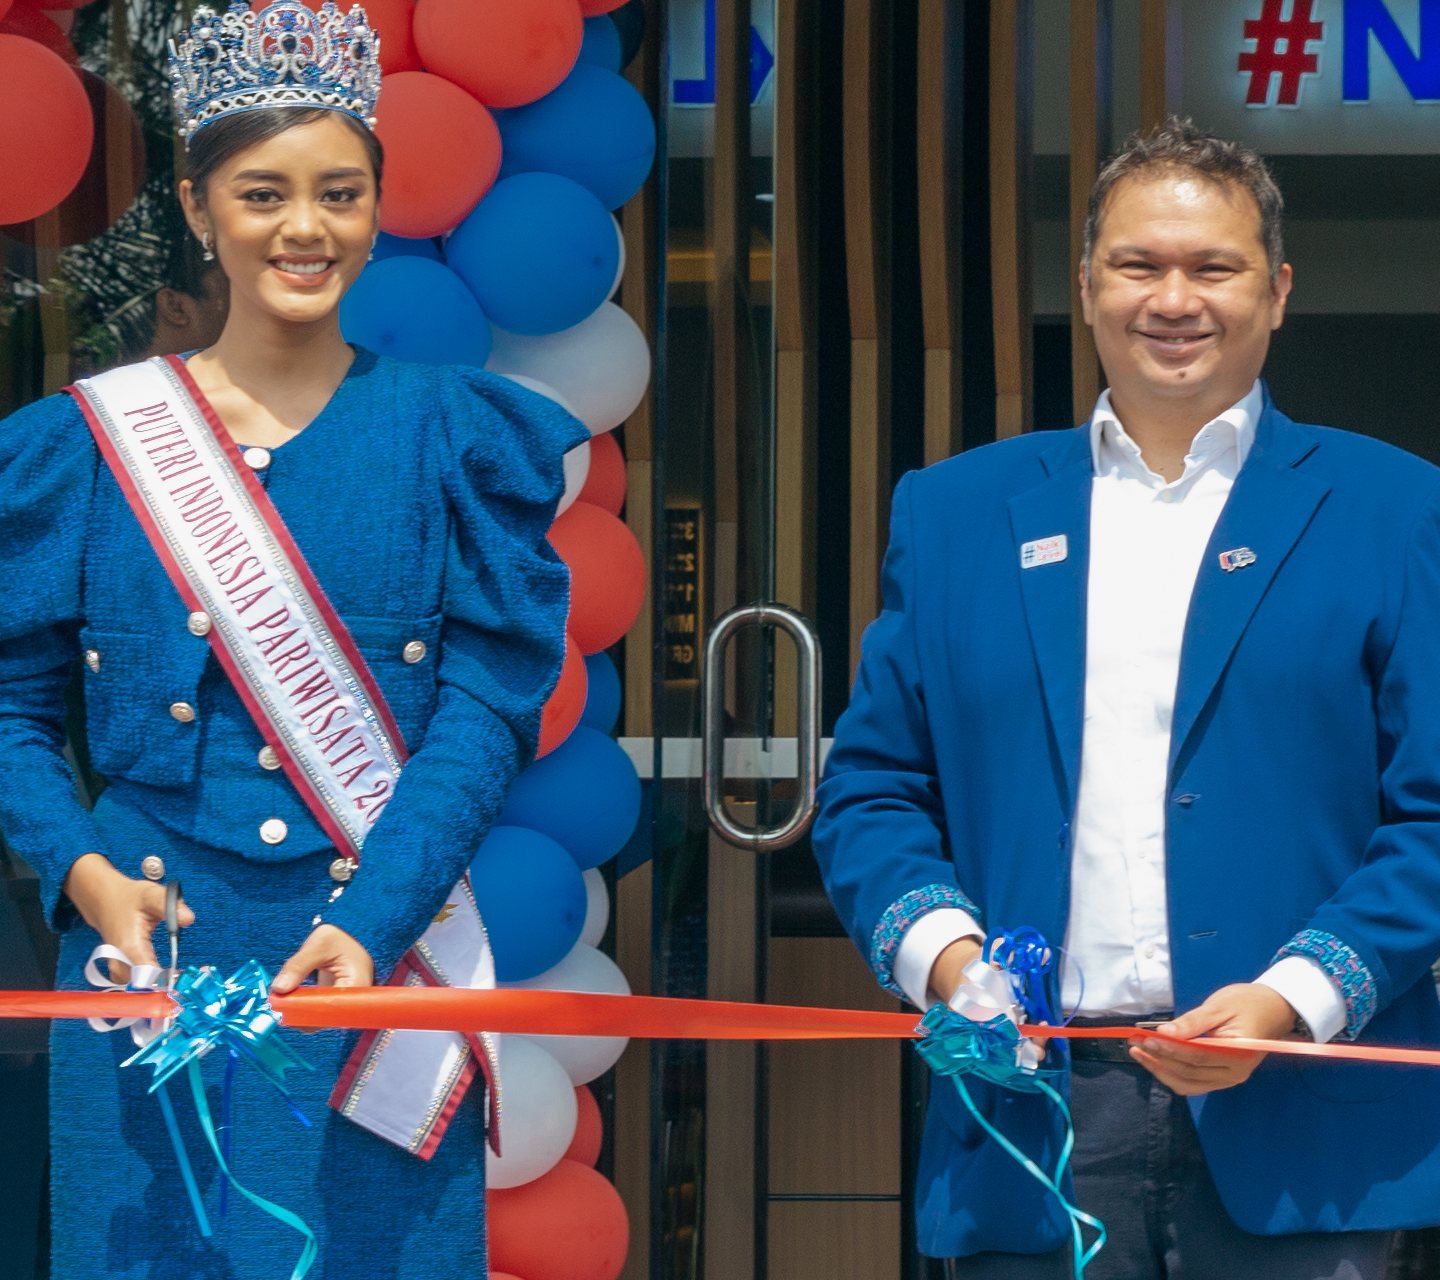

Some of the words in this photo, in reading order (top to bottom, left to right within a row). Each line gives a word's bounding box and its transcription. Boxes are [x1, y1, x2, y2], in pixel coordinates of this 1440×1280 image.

[123, 400, 204, 481] PUTERI
[169, 475, 276, 616] INDONESIA
[246, 604, 375, 792] PARIWISATA
